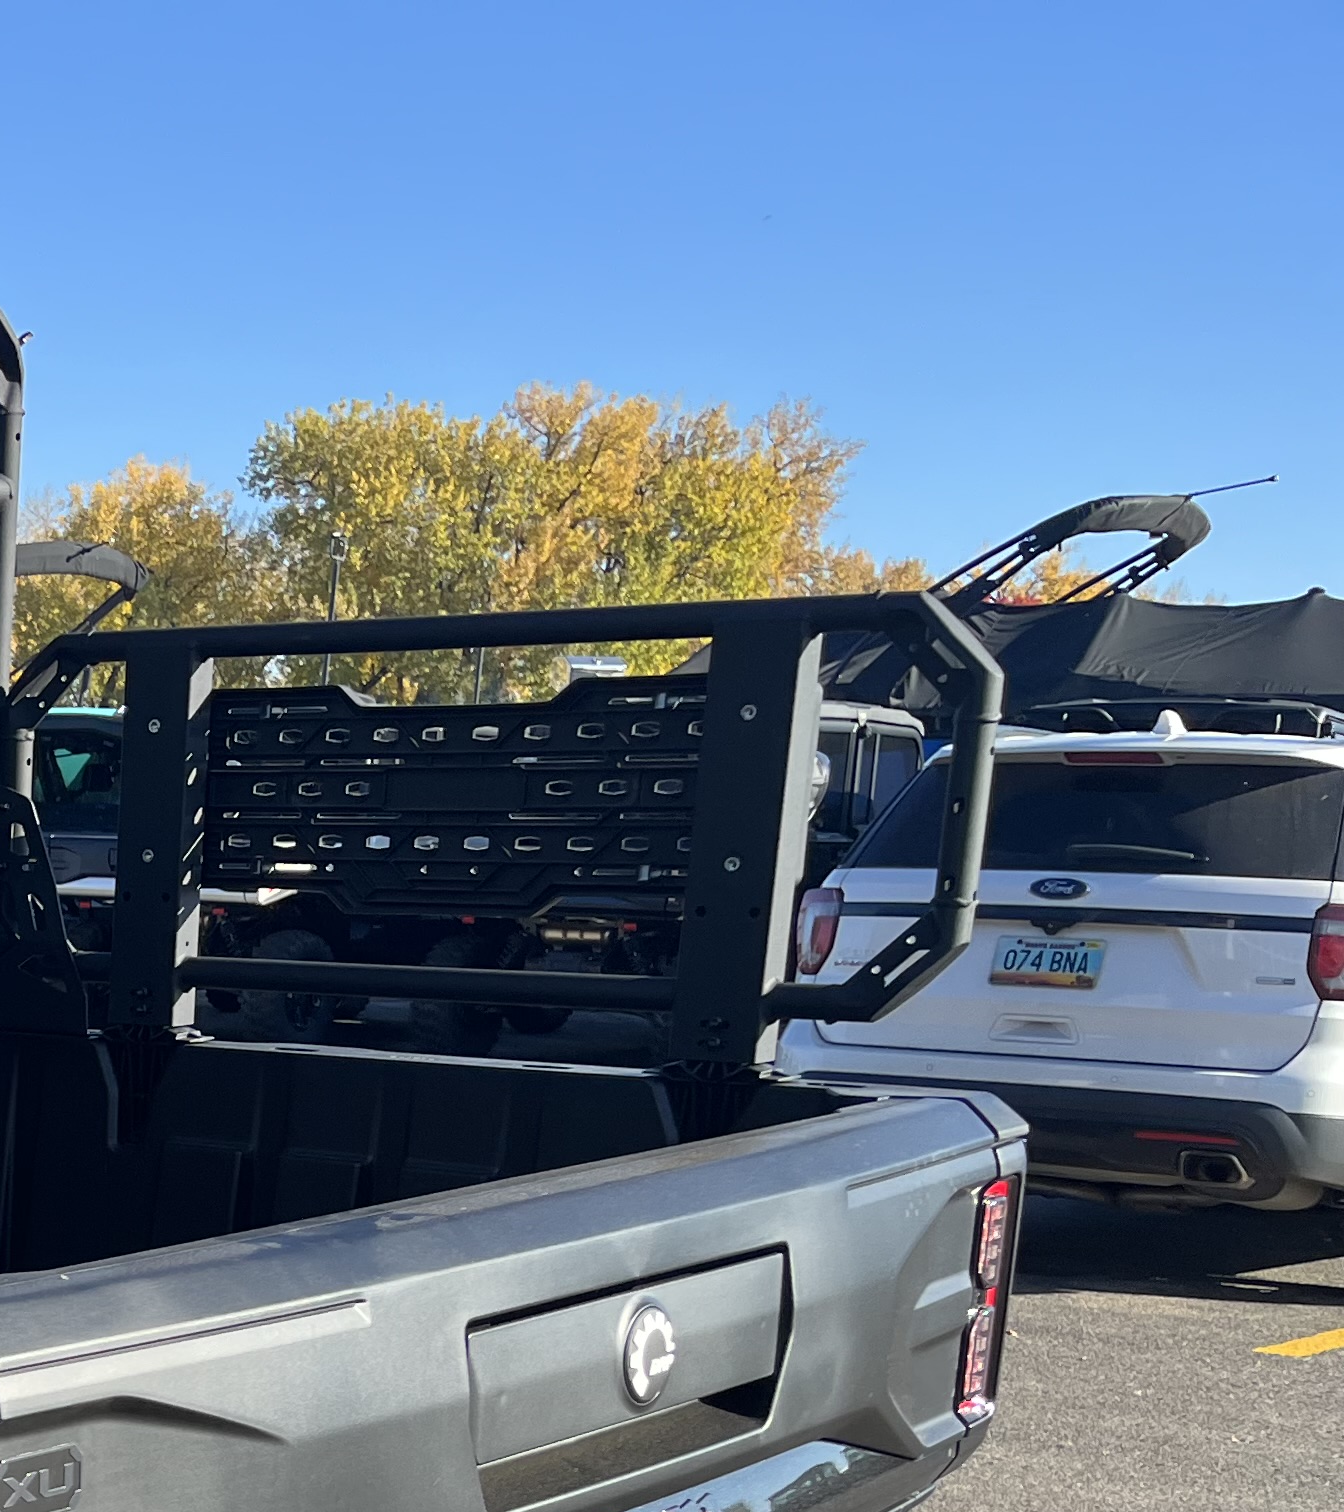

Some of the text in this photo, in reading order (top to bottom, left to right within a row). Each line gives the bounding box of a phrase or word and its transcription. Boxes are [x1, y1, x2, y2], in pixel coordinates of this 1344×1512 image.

[1039, 879, 1076, 895] Ford
[1003, 949, 1089, 974] 074 BNA
[3, 1462, 75, 1509] XU
